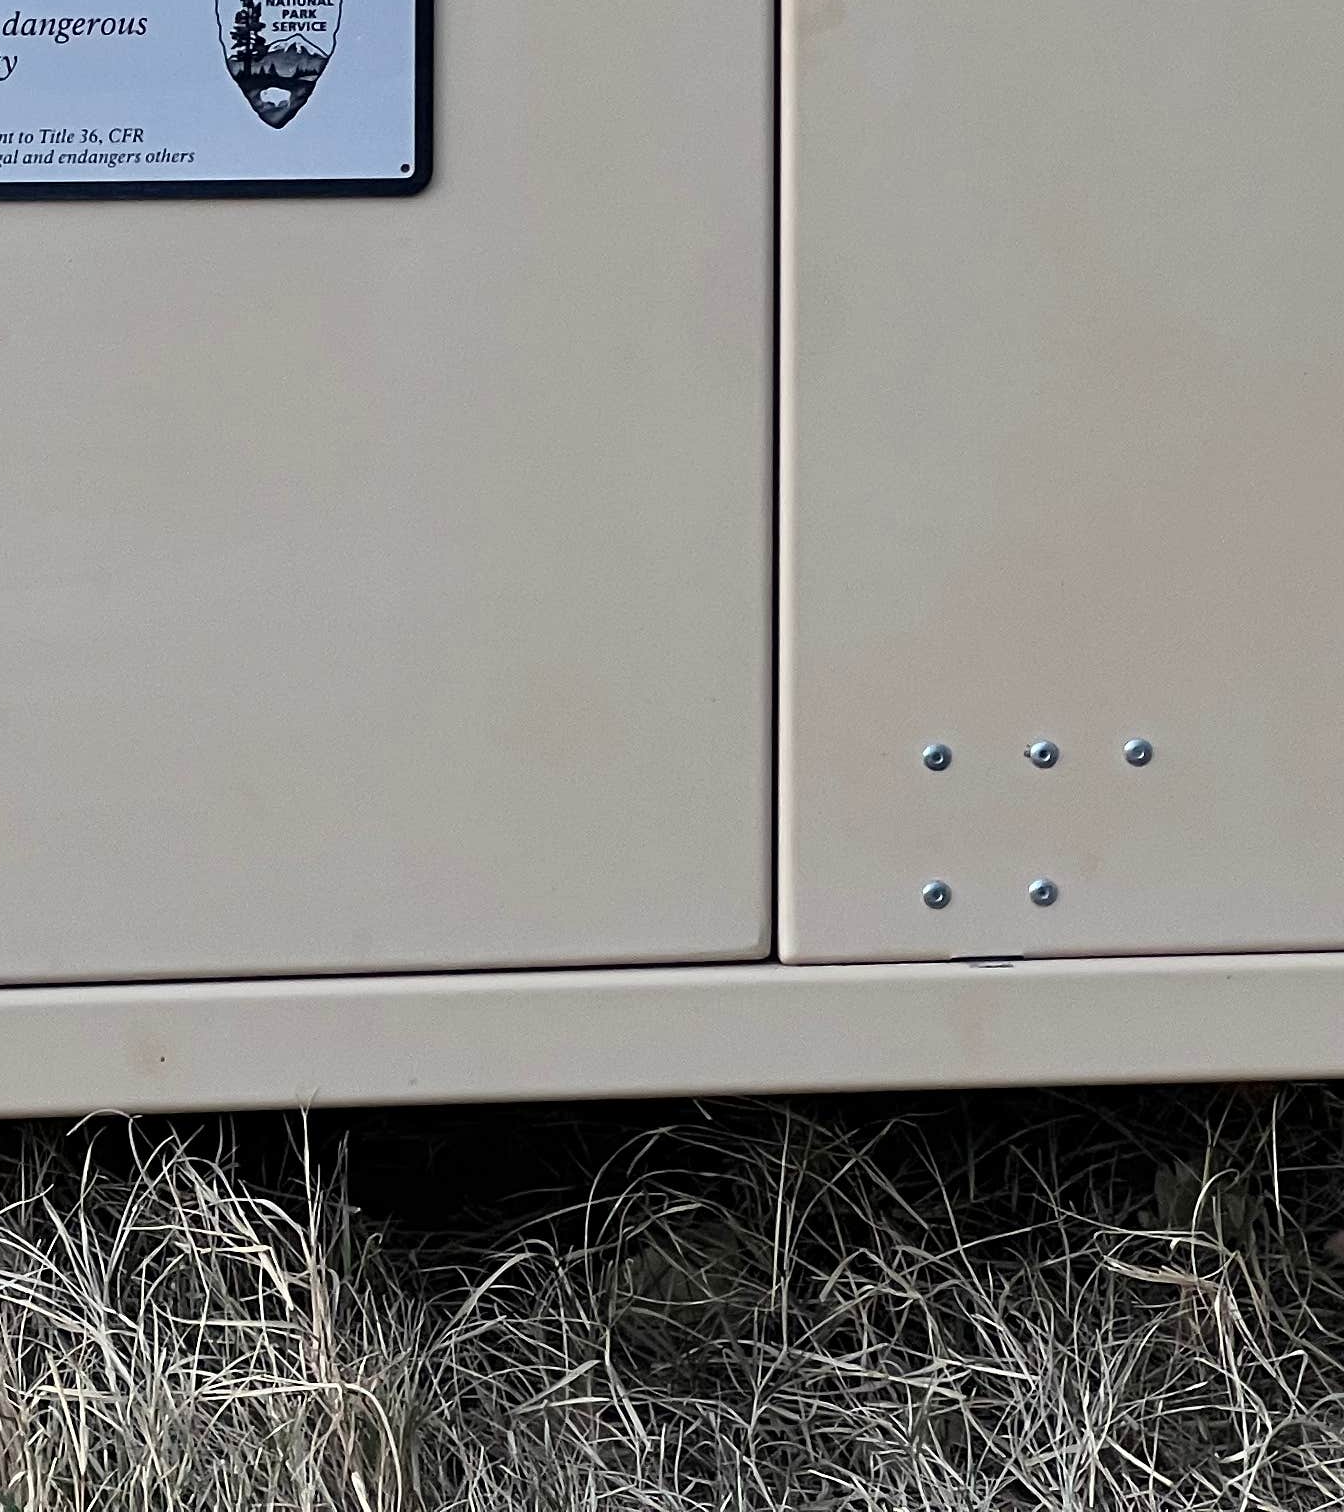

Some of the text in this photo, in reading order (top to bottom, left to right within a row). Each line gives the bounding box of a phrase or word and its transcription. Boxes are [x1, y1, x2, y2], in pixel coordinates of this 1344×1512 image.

[282, 9, 316, 19] PARK
[3, 11, 147, 44] dangerous
[272, 22, 327, 32] SERVICE
[19, 132, 33, 144] to
[39, 129, 74, 143] Title
[80, 129, 102, 144] 36,
[109, 128, 143, 143] CFR
[23, 150, 54, 164] and
[58, 149, 141, 168] endangers
[146, 148, 195, 163] others
